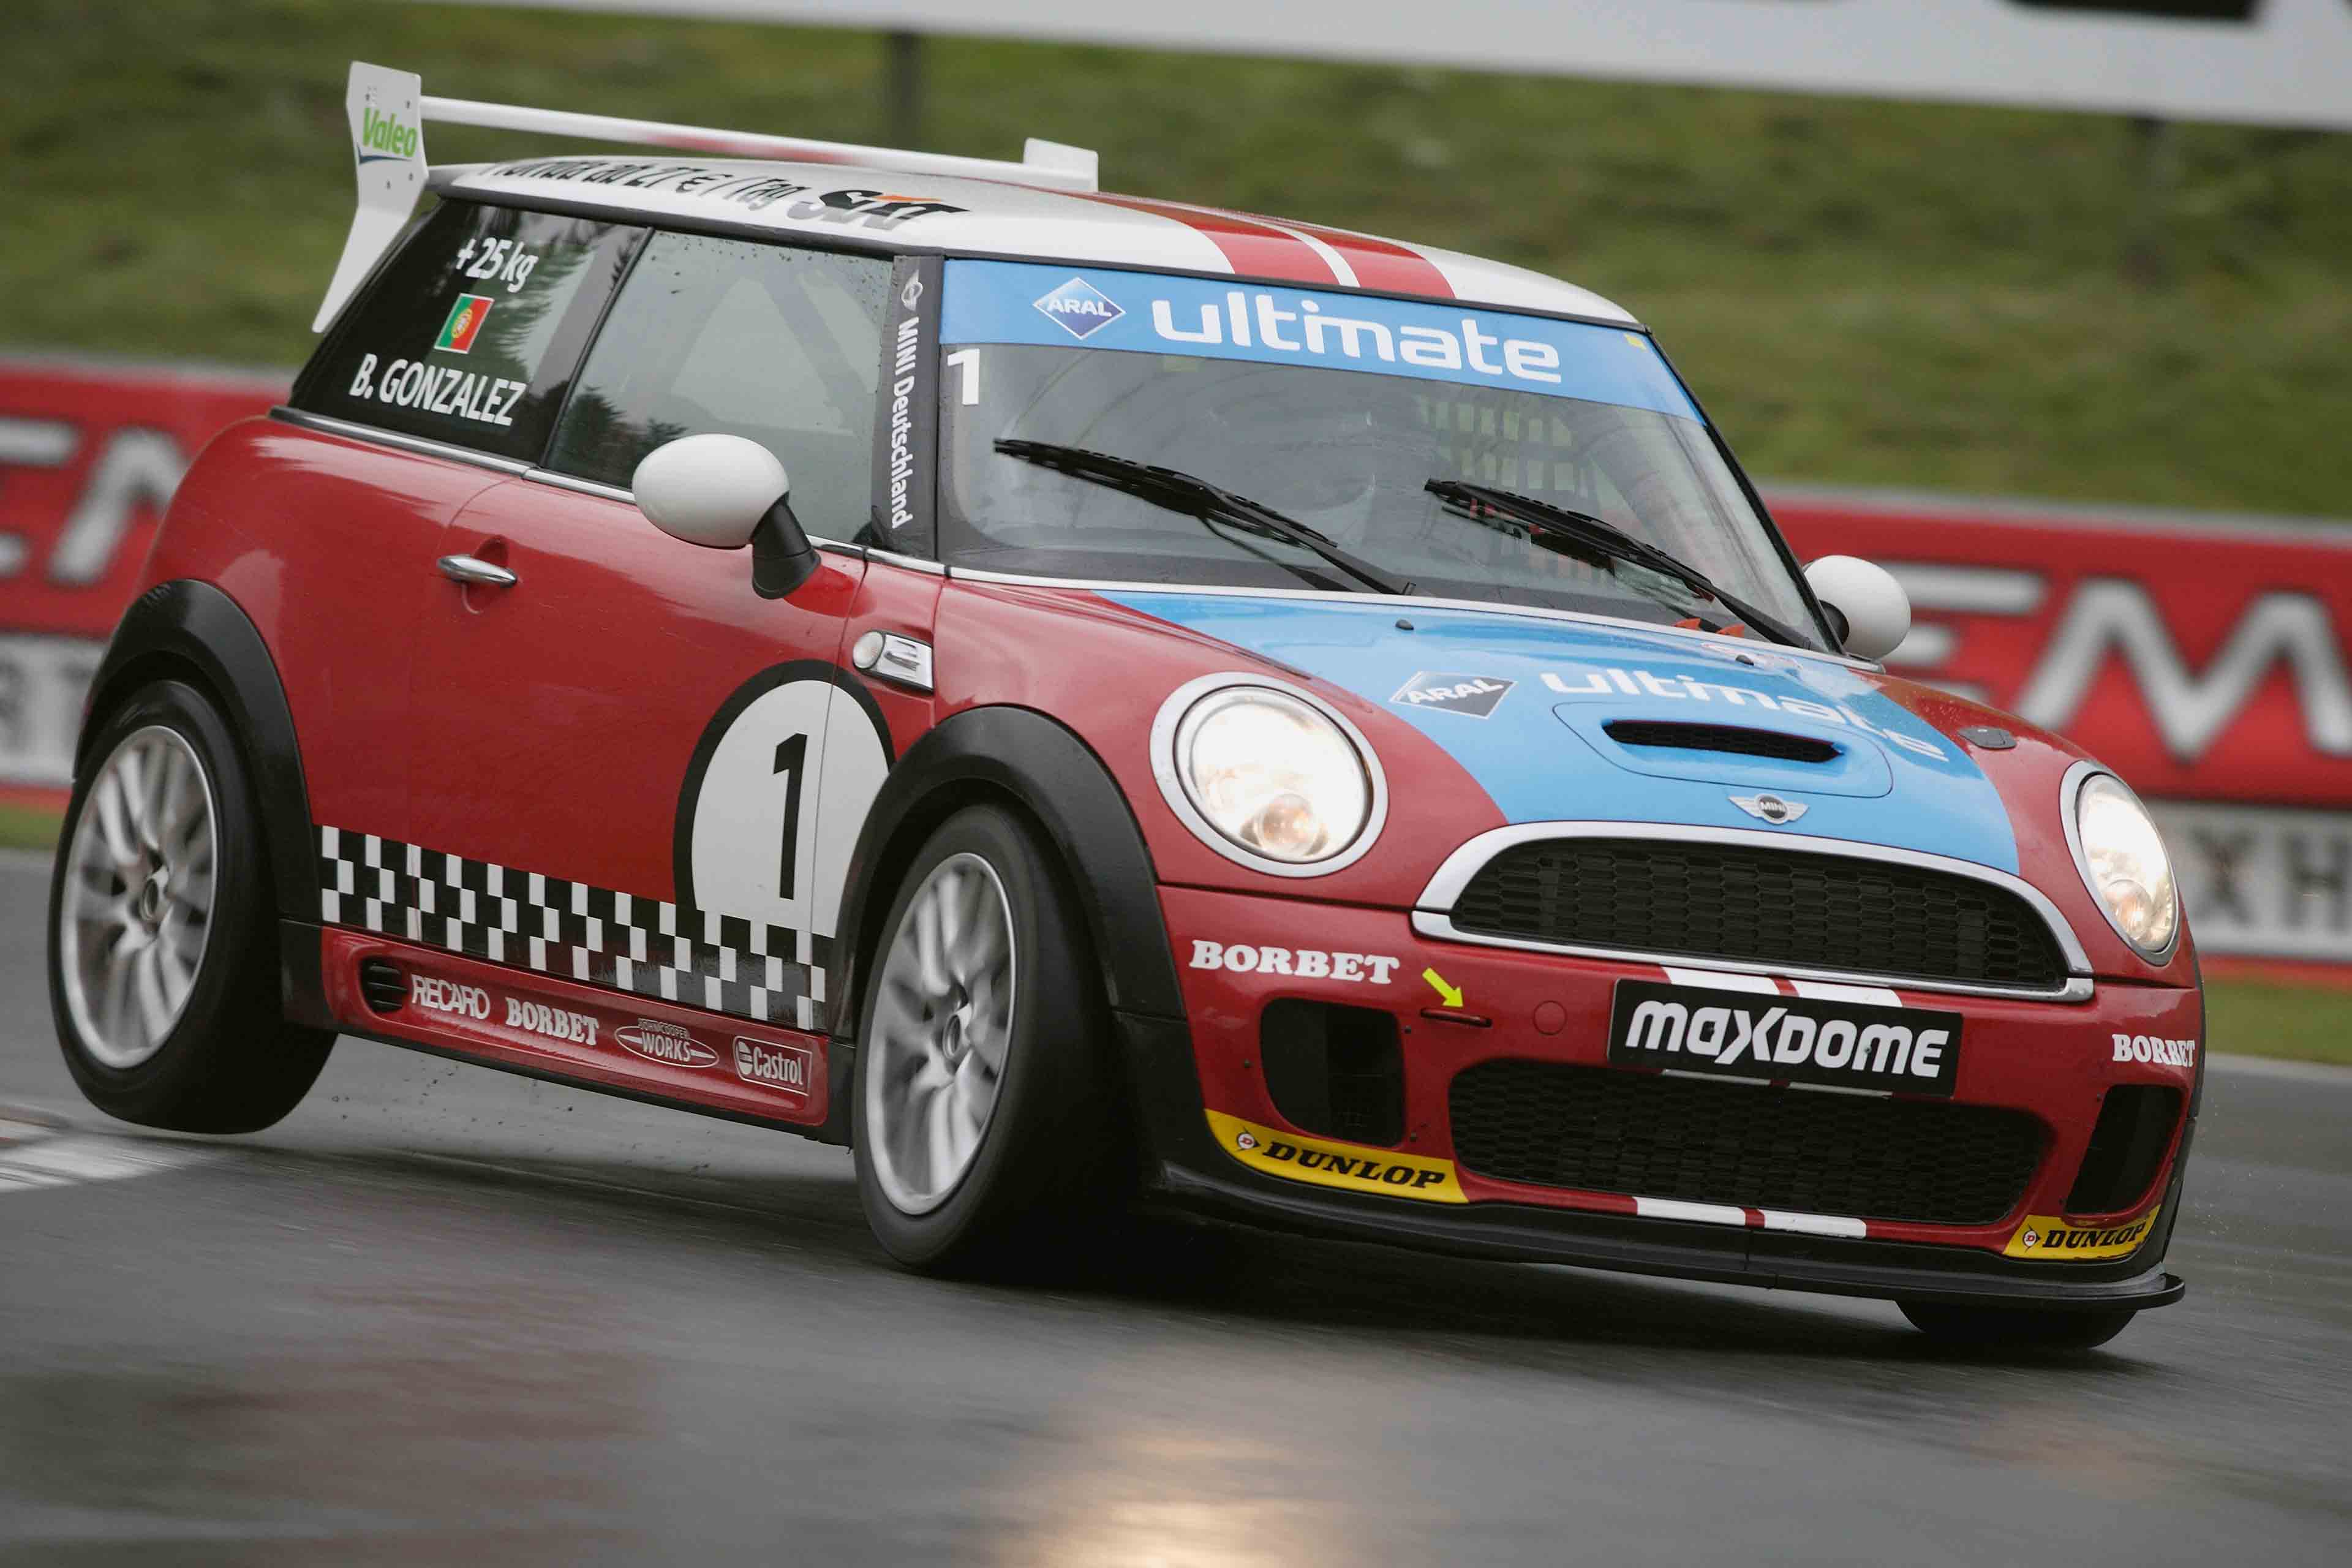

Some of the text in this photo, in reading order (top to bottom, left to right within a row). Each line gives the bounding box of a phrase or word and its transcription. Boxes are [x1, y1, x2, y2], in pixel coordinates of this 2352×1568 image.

[363, 107, 418, 157] Valeo
[1047, 298, 1113, 317] ARAL
[1152, 291, 1562, 383] ultimate
[349, 353, 527, 426] B. GONZALEZ
[947, 348, 980, 406] 1
[891, 316, 919, 530] MINI Deutschland
[1408, 679, 1505, 703] ARAL
[1539, 668, 1950, 761] ultimate
[773, 732, 809, 901] 1
[1189, 939, 1401, 985] BORBET
[410, 974, 490, 1021] RECARO
[505, 997, 599, 1047] BORBET
[641, 1031, 692, 1063] WORKS
[753, 1046, 804, 1086] Castrol
[2111, 1033, 2196, 1068] BORBET
[1262, 1140, 1446, 1189] DUNLOP
[2041, 1220, 2147, 1250] DUNLOP
